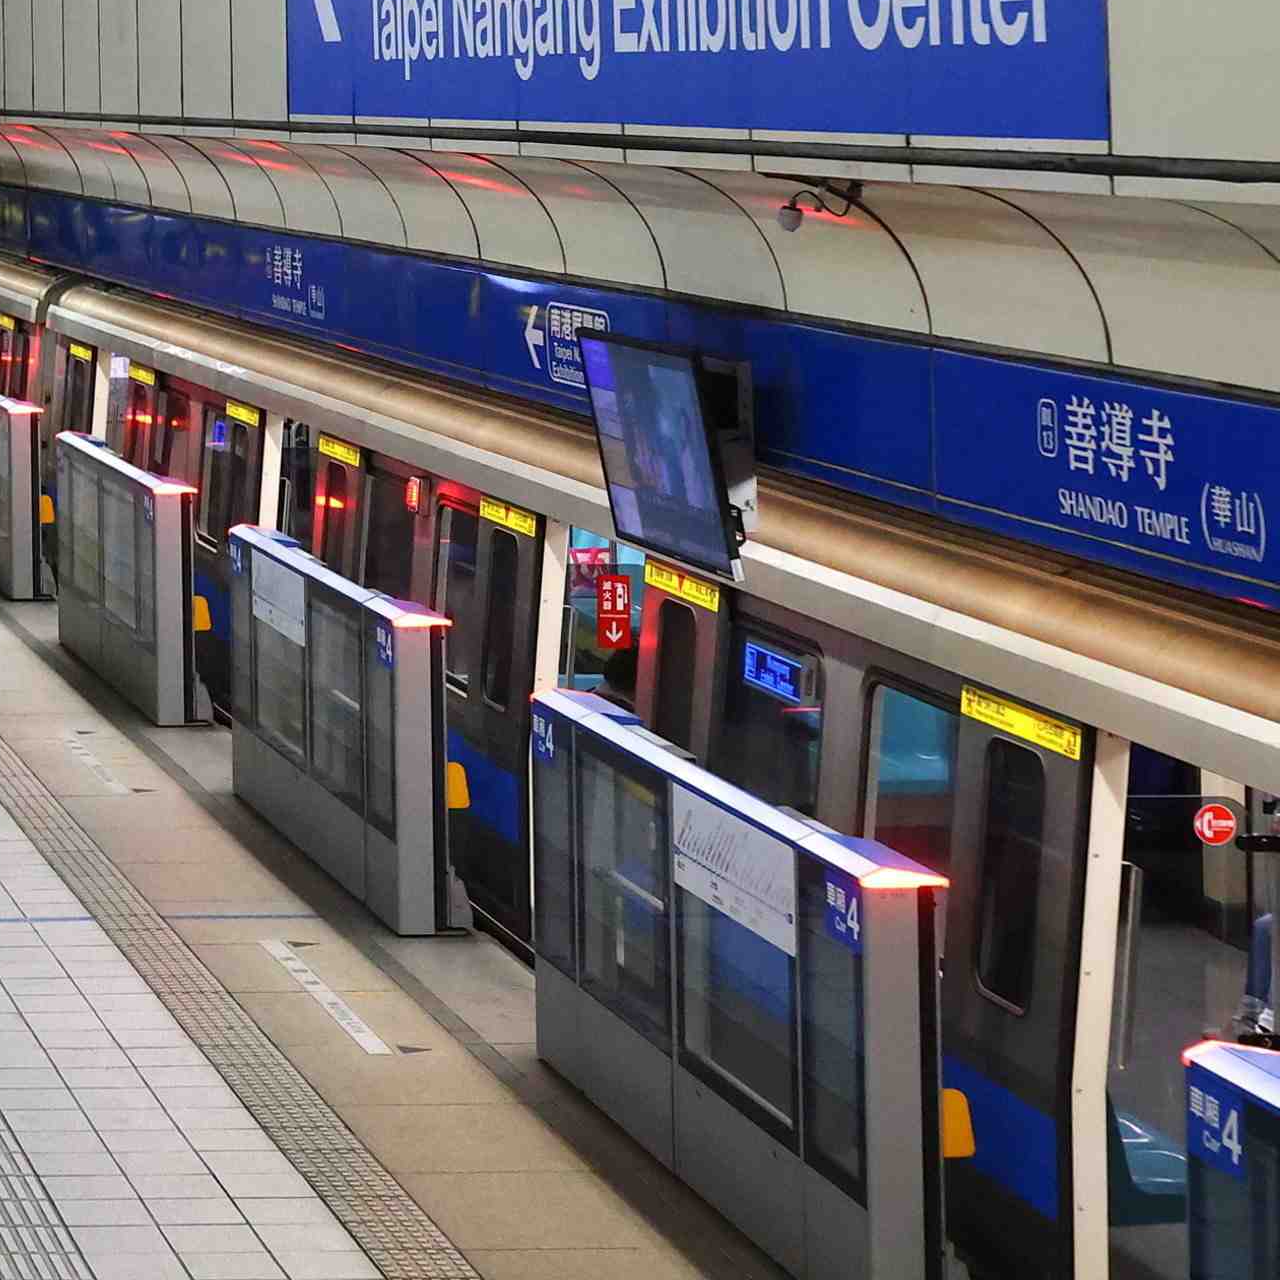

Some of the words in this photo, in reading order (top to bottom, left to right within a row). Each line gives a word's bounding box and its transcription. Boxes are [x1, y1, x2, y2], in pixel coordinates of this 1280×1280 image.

[1064, 394, 1175, 491] 善導寺
[1058, 488, 1128, 529] SHANDAO
[1134, 505, 1191, 545] TEMPLE
[546, 723, 553, 758] 4
[847, 897, 860, 941] 4
[1222, 1109, 1242, 1166] 4
